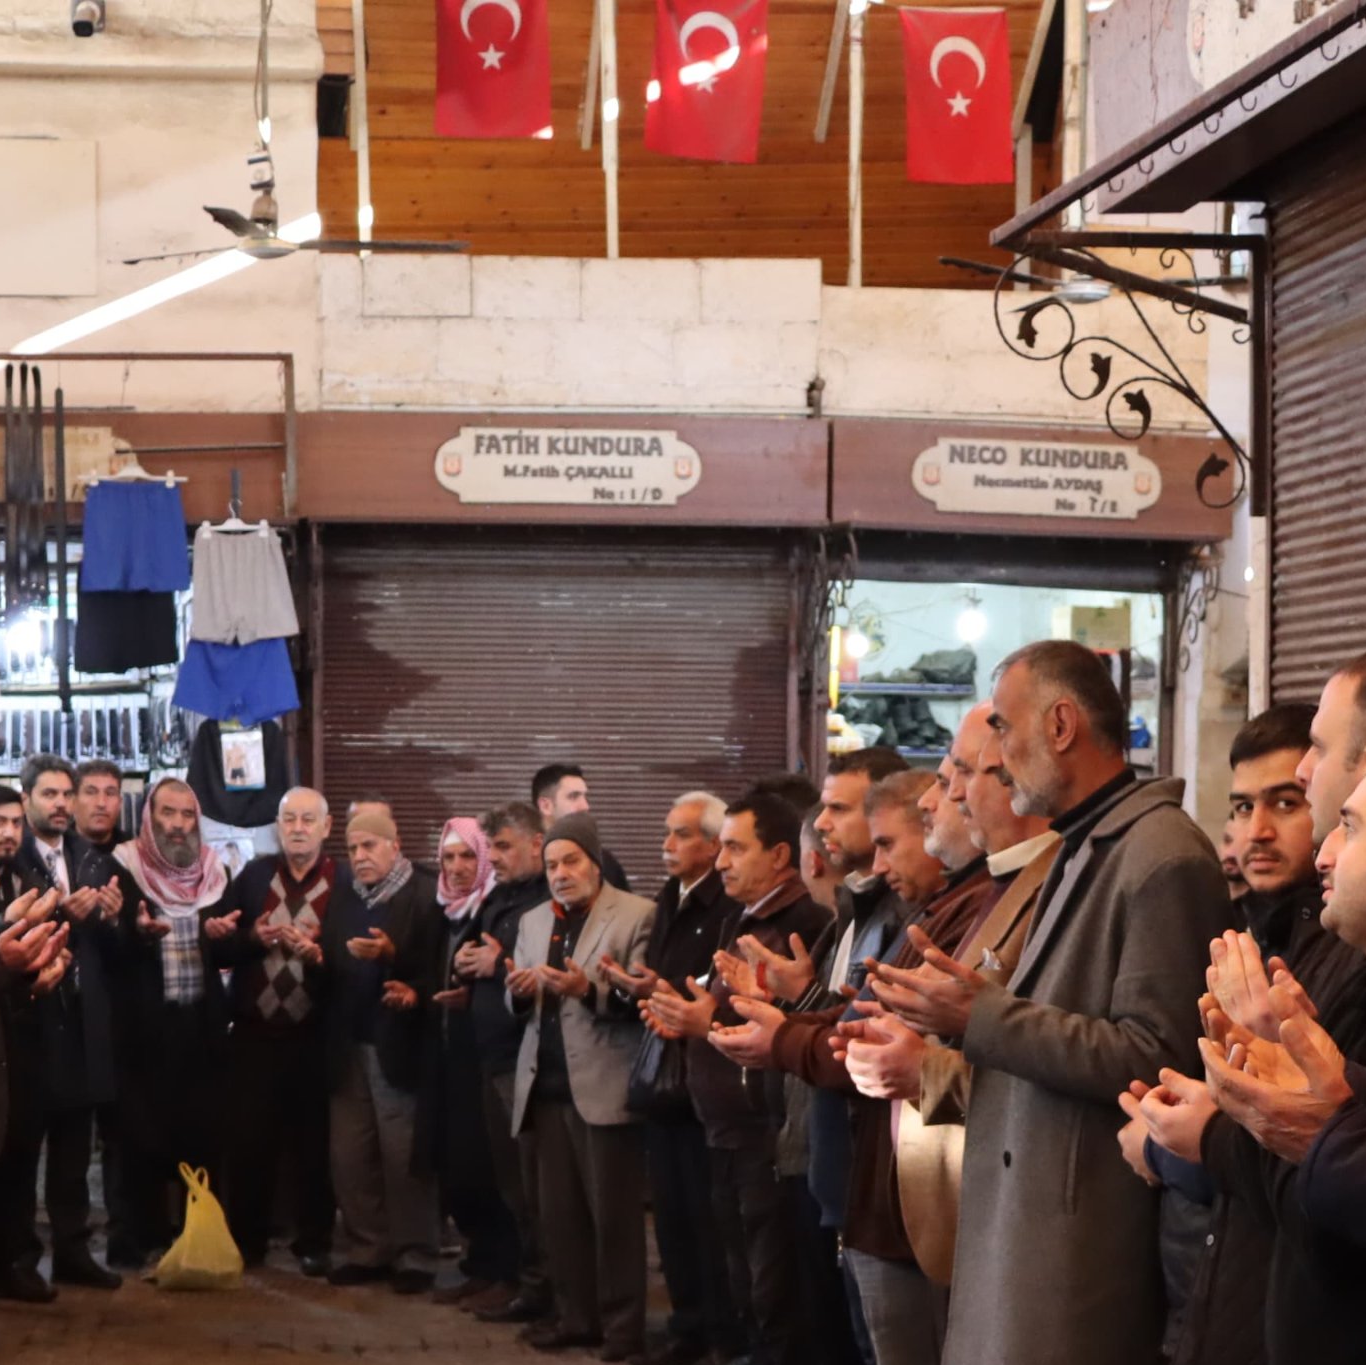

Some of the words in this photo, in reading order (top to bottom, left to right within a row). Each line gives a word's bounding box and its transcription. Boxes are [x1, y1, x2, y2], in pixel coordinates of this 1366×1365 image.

[473, 430, 540, 456] FATİH
[547, 435, 664, 457] KUNDURA
[948, 444, 1007, 465] NECO
[1019, 447, 1129, 471] KUNDURA
[564, 465, 633, 481] ÇAKALLI
